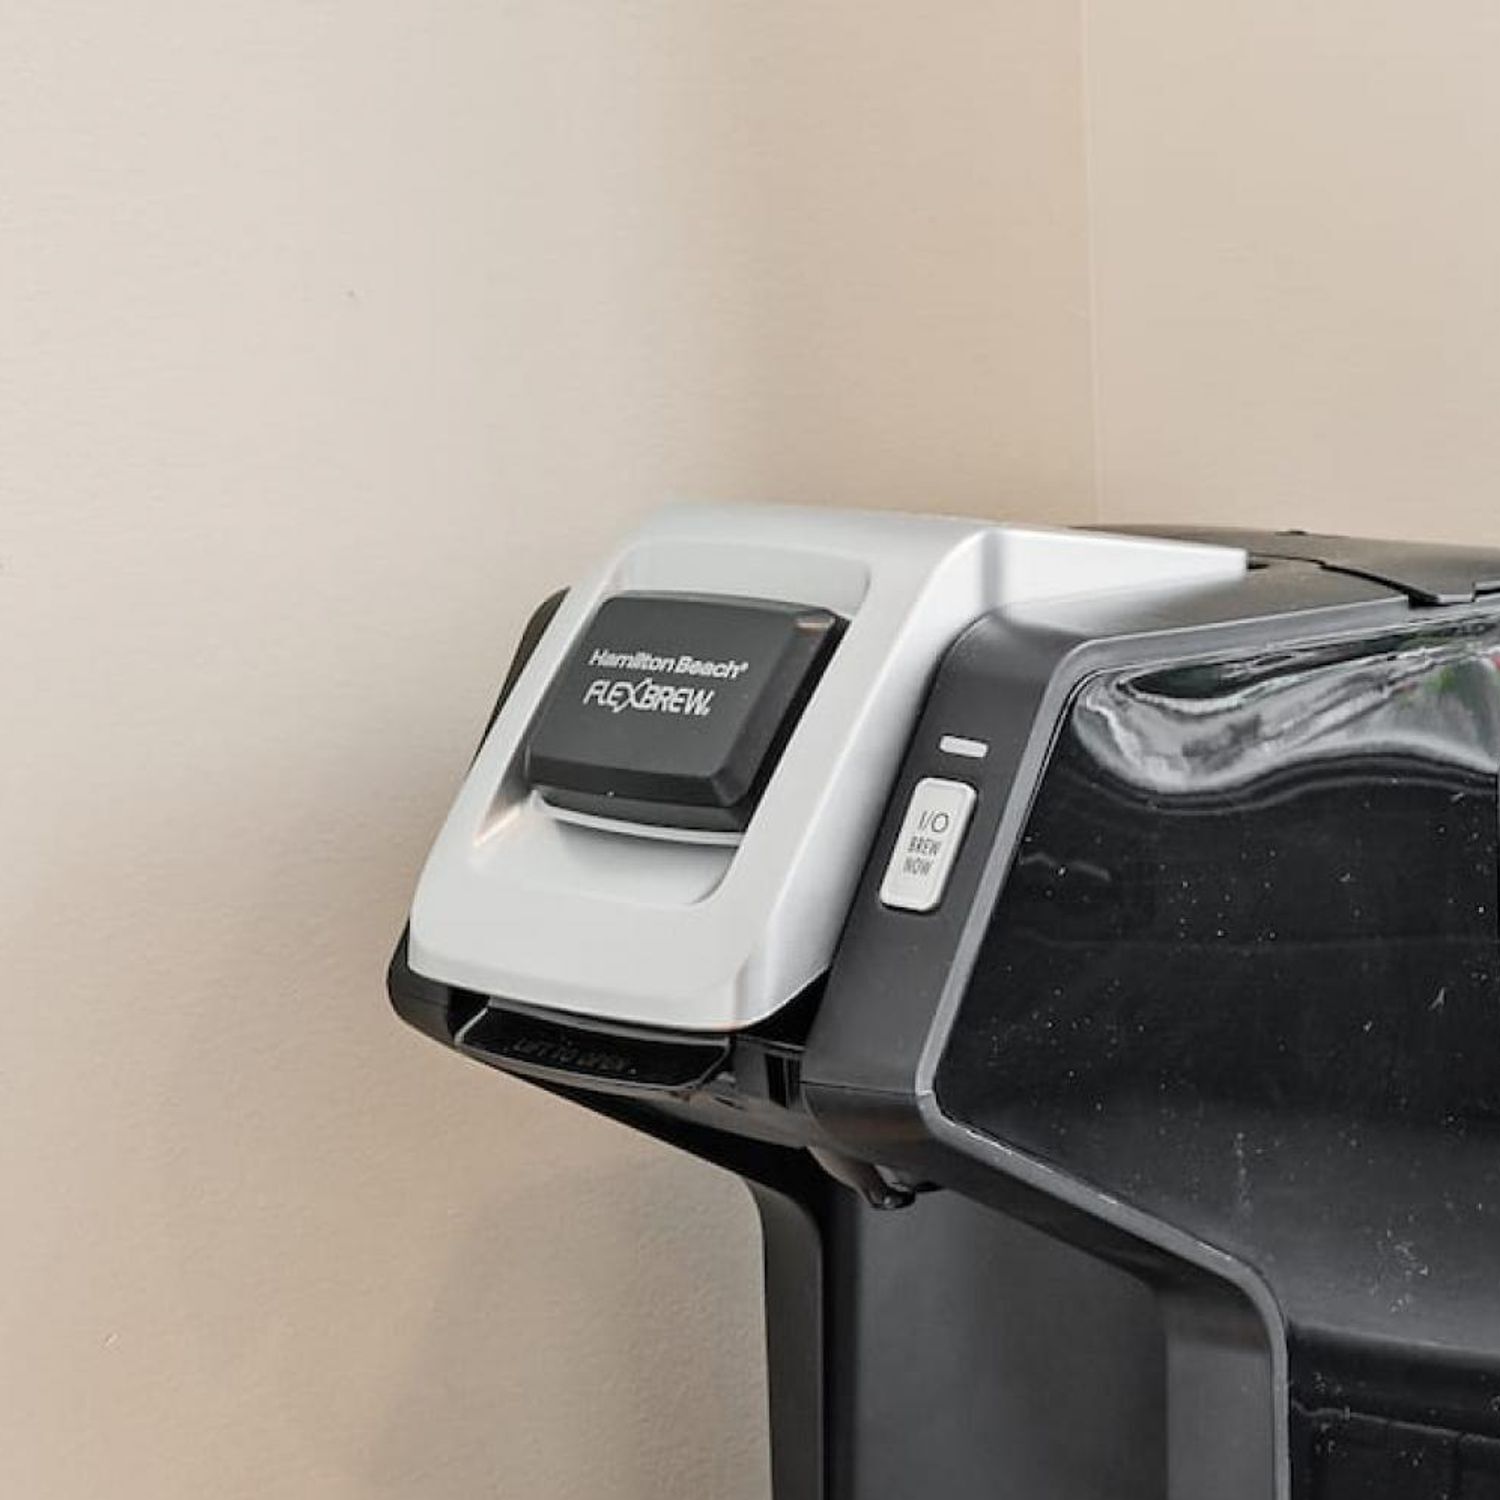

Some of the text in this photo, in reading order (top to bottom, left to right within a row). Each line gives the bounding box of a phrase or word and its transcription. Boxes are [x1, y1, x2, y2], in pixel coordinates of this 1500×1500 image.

[588, 648, 675, 673] Hamilton
[908, 835, 942, 856] BREW
[903, 856, 935, 876] NOW
